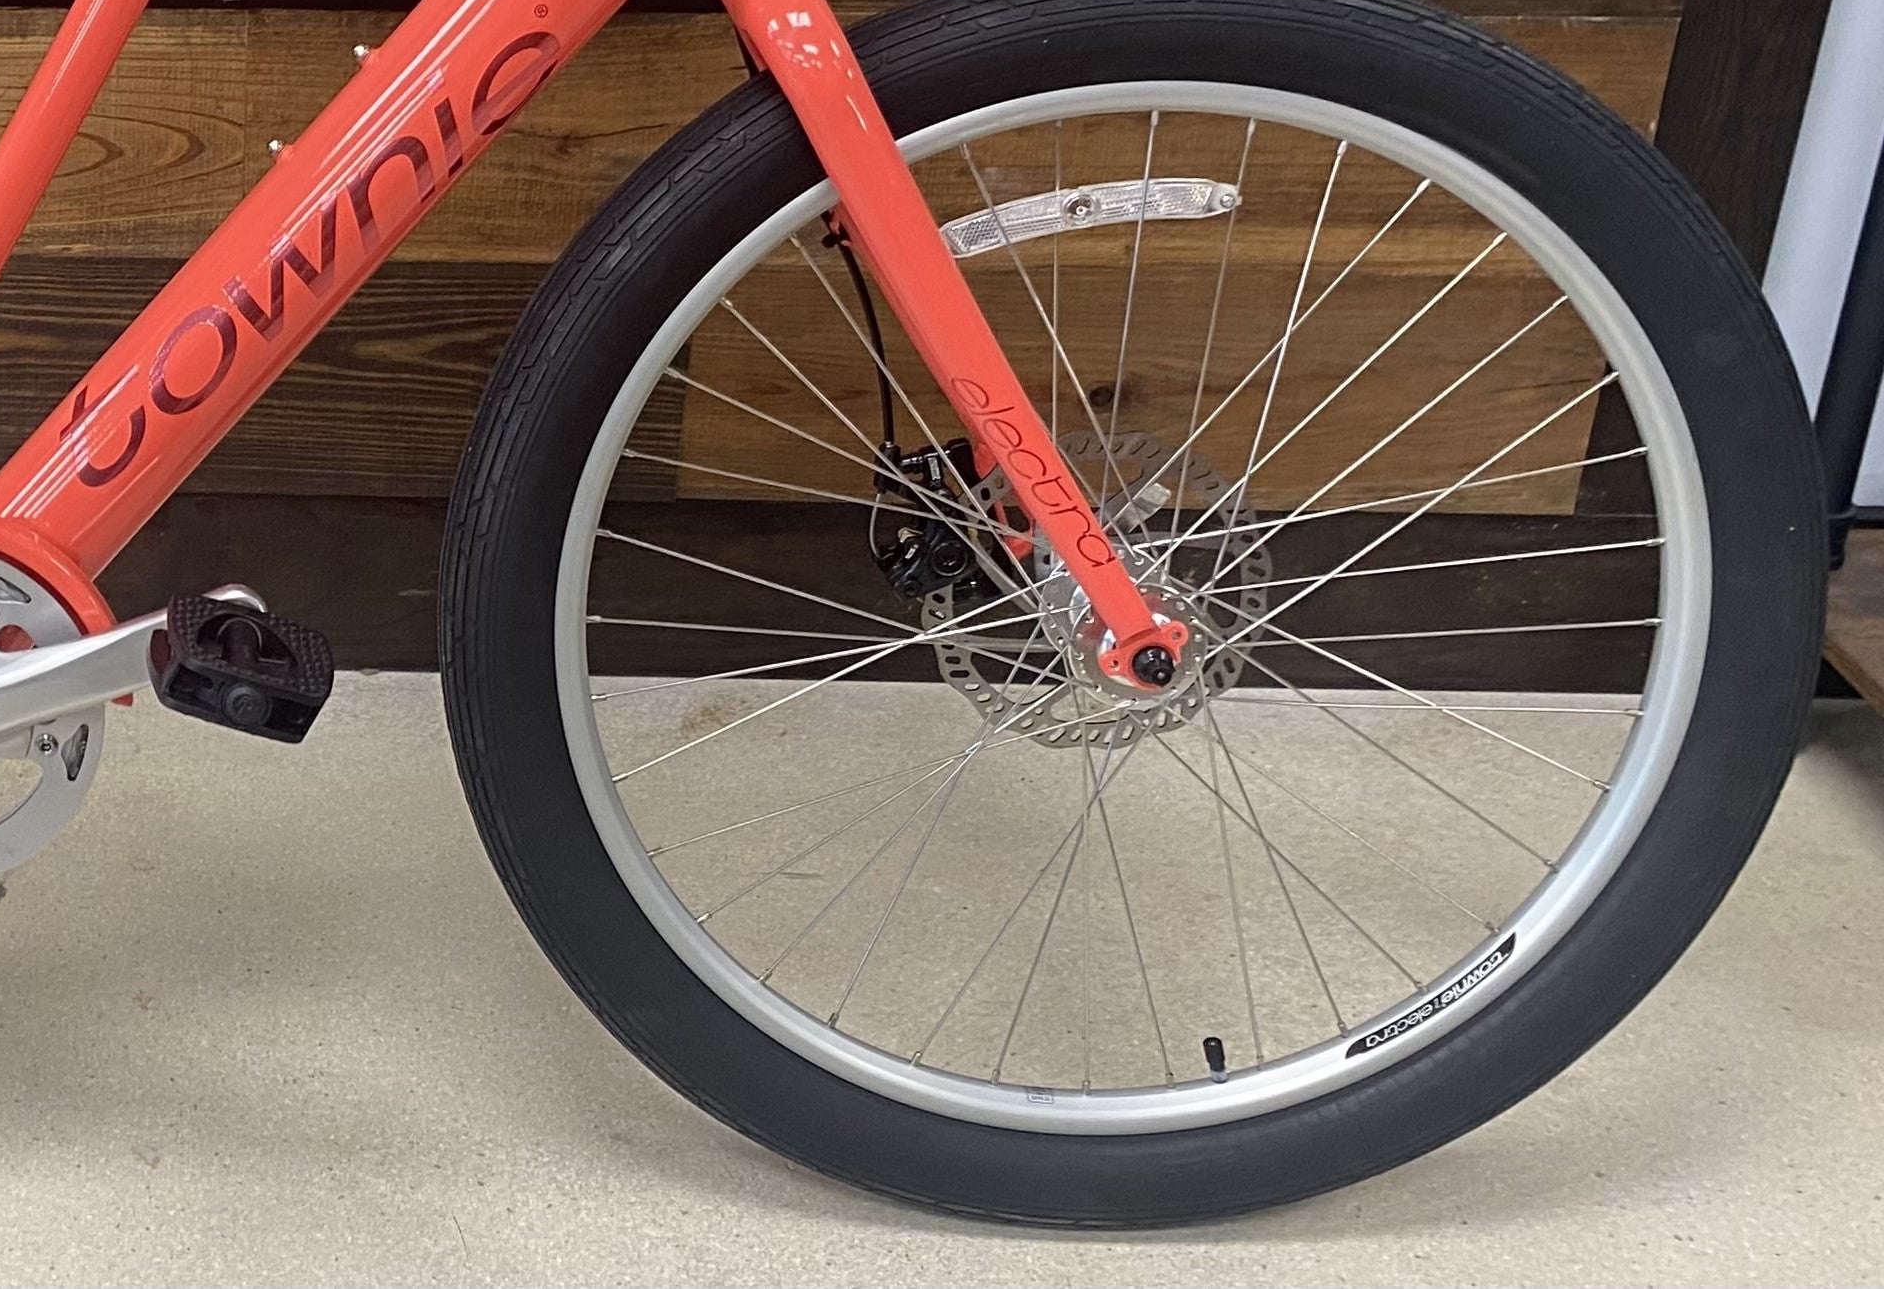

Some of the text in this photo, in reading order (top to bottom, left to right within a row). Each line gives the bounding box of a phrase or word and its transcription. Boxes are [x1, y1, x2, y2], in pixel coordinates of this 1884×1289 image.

[59, 30, 561, 488] townie
[950, 377, 1116, 568] electra
[1365, 951, 1509, 1048] townie electra
